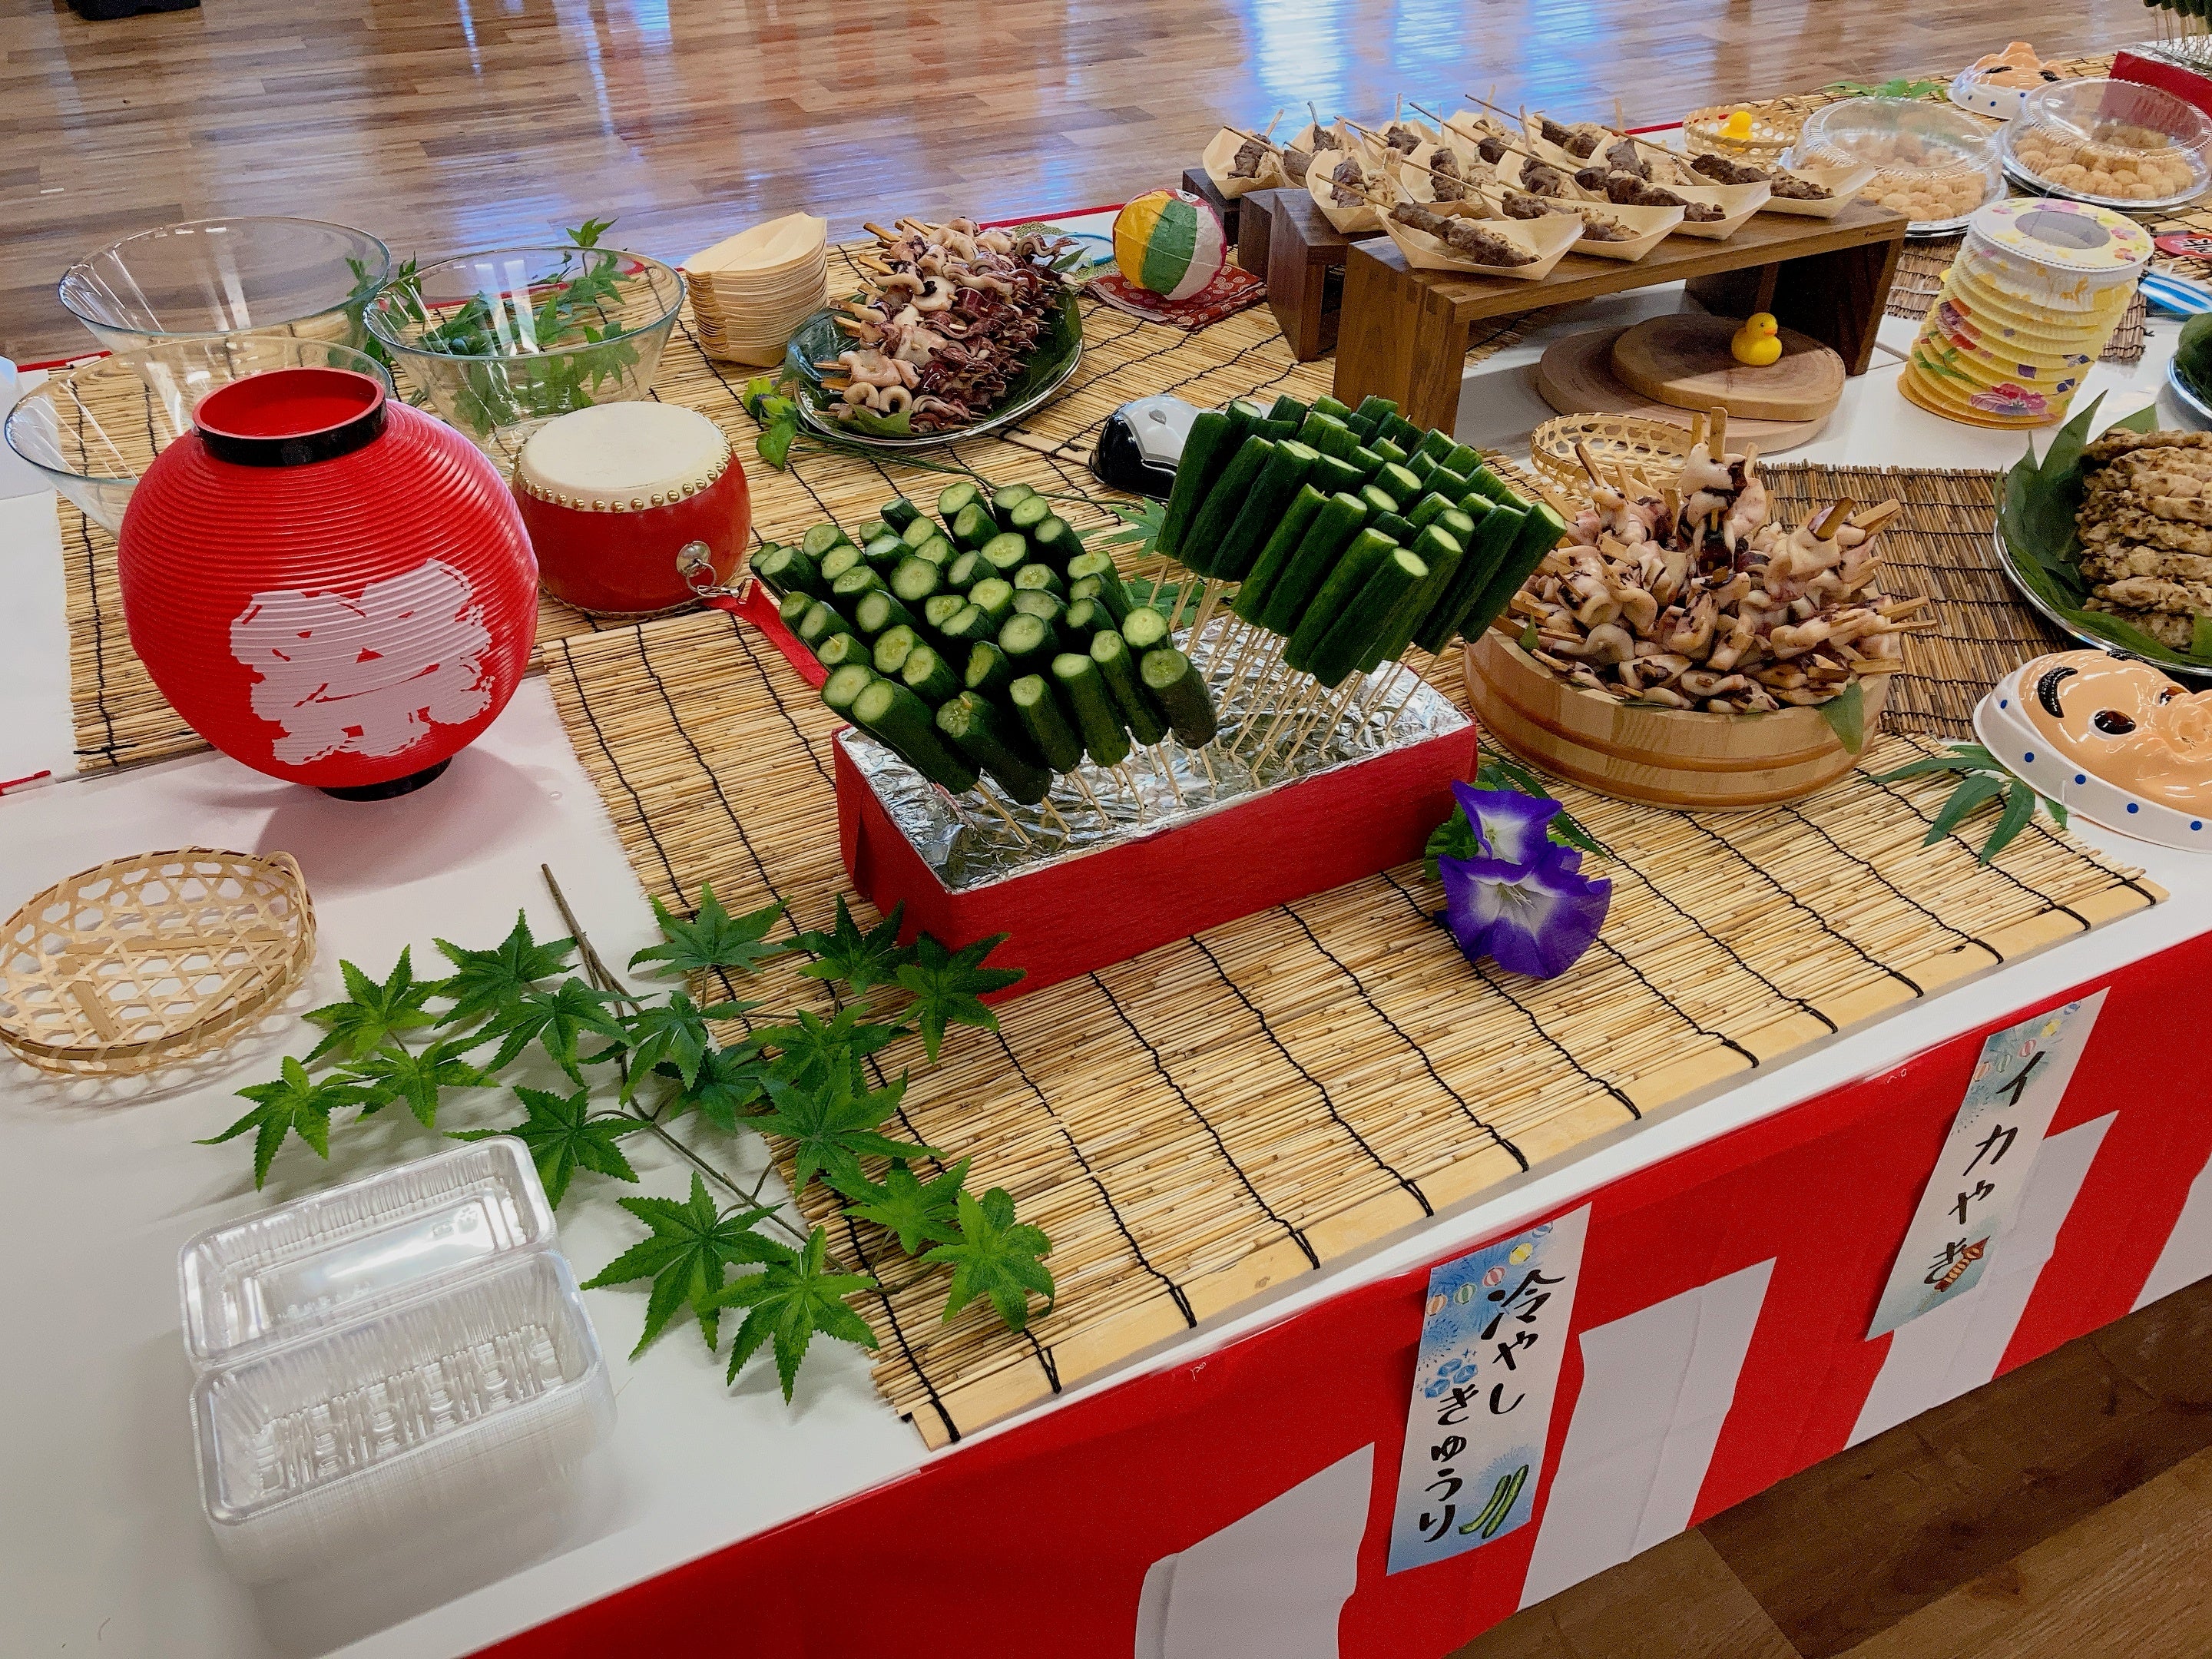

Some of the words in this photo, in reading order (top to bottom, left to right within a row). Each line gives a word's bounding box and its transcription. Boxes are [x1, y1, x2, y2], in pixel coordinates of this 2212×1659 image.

[230, 558, 494, 764] 祭
[1923, 1051, 2046, 1284] イカやき
[1481, 1269, 1566, 1415] 冷やし
[1419, 1383, 1479, 1543] きゅうり
